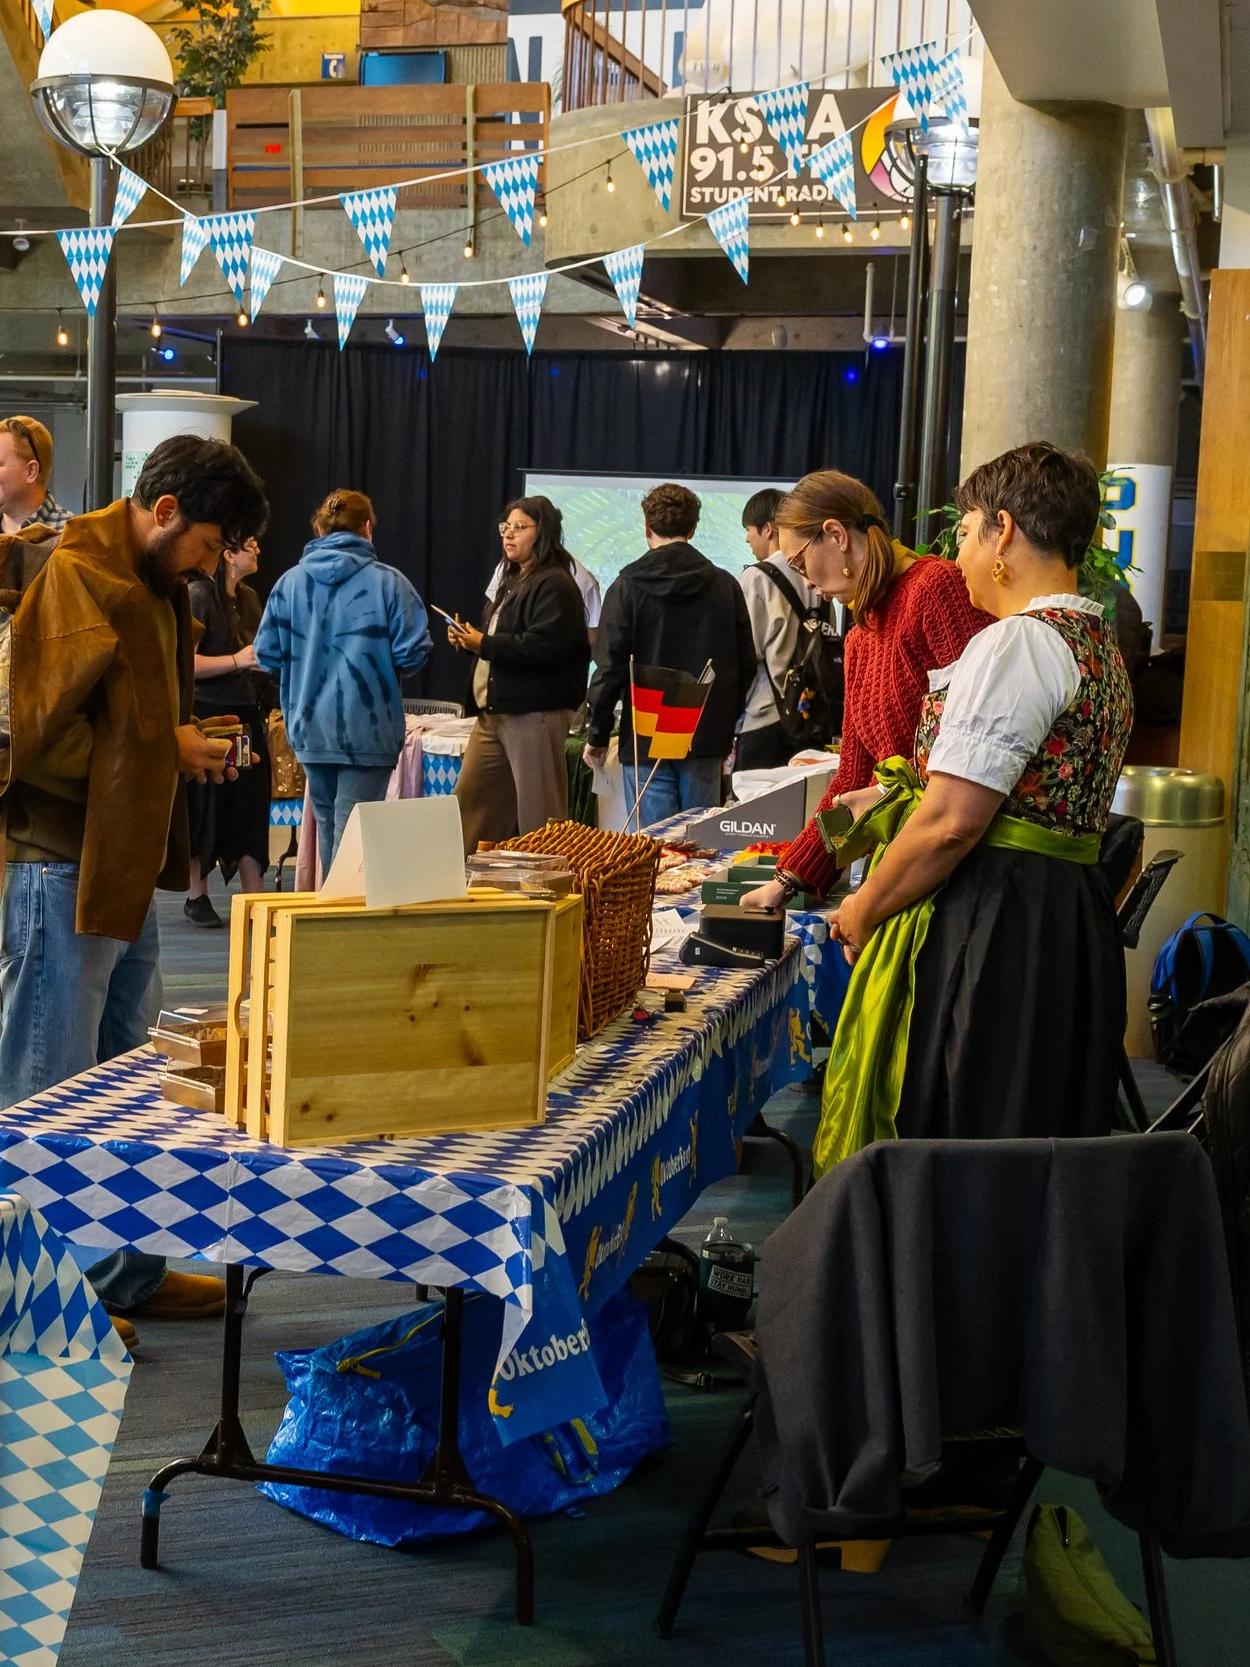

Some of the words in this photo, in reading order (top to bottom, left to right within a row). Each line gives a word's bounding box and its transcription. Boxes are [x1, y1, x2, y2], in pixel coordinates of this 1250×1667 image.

[695, 93, 848, 144] KSA
[690, 145, 774, 182] 91.5
[690, 185, 781, 204] STUDENT
[786, 185, 833, 202] RADI
[719, 820, 775, 836] GILDAN
